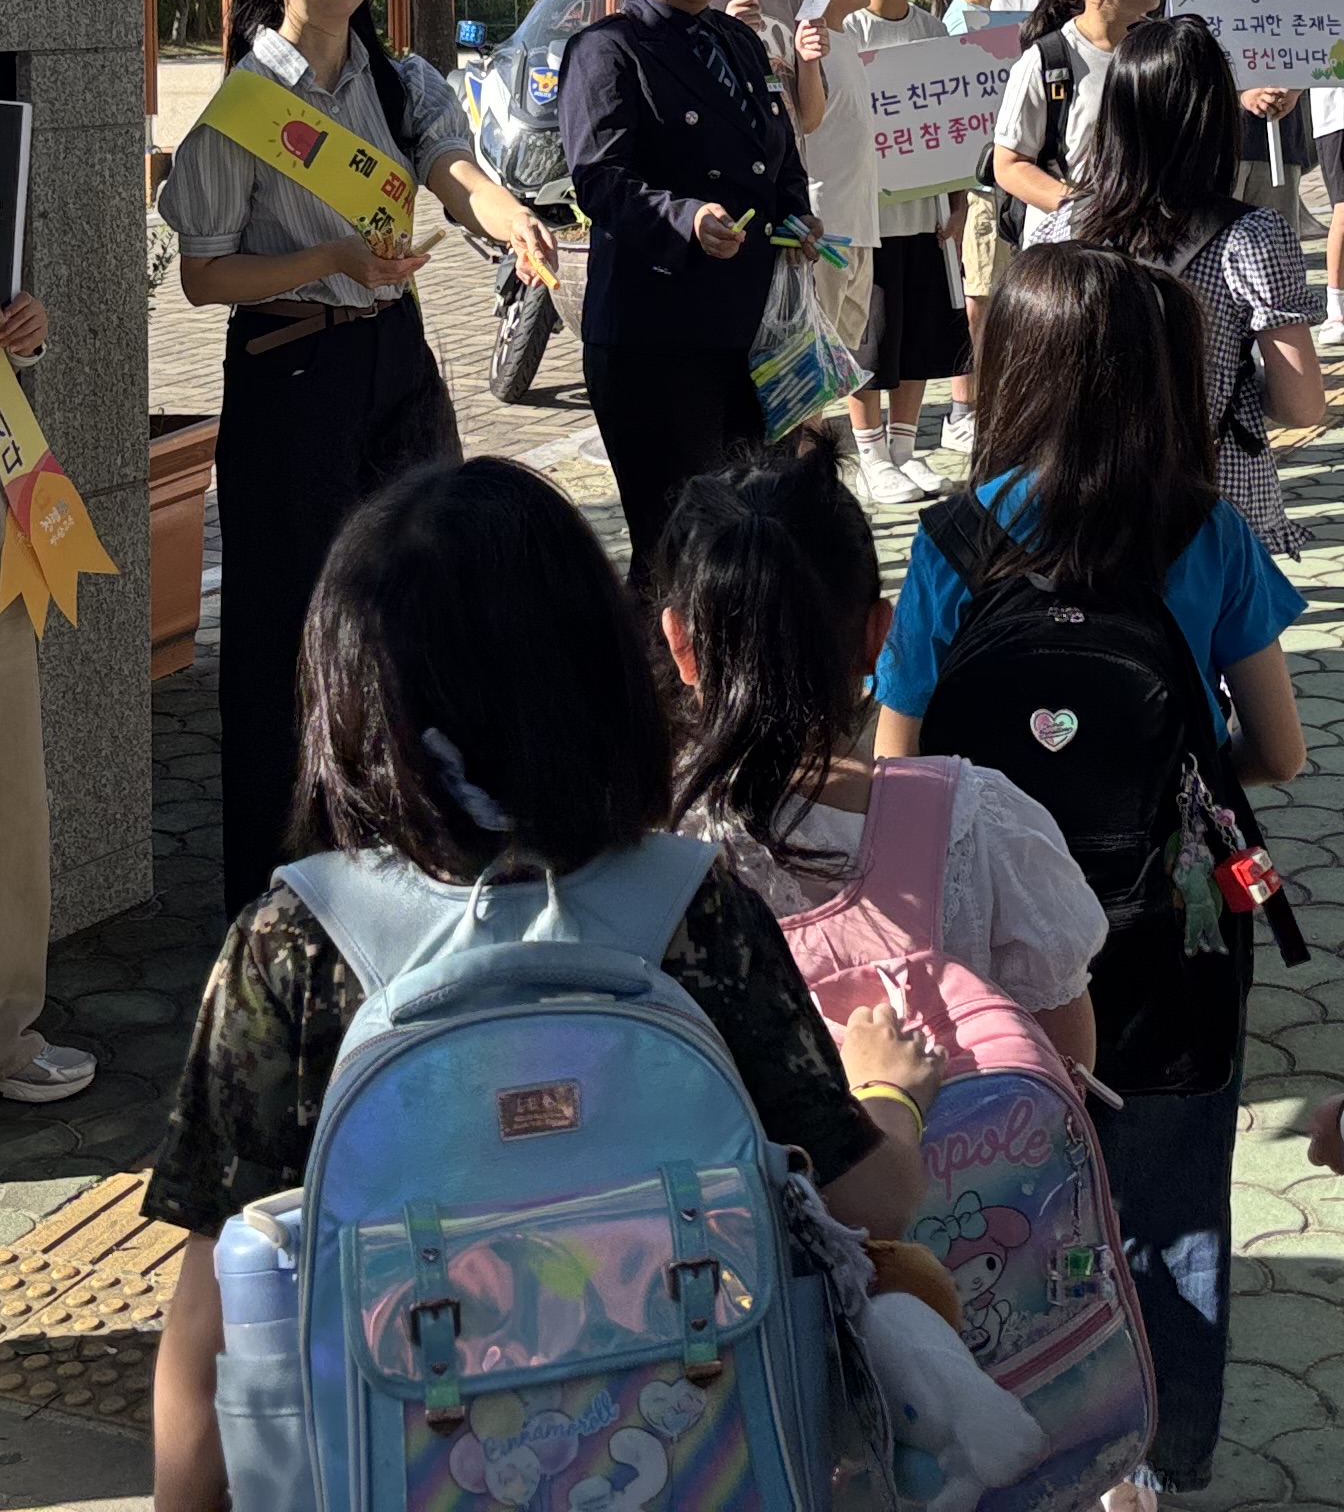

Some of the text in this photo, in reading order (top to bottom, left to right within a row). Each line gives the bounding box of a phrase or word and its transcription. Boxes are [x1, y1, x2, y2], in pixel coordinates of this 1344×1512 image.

[1207, 14, 1342, 37] 장 고귀한 존재는
[907, 75, 970, 110] 친구가
[874, 127, 914, 159] 우린
[920, 122, 941, 150] 참
